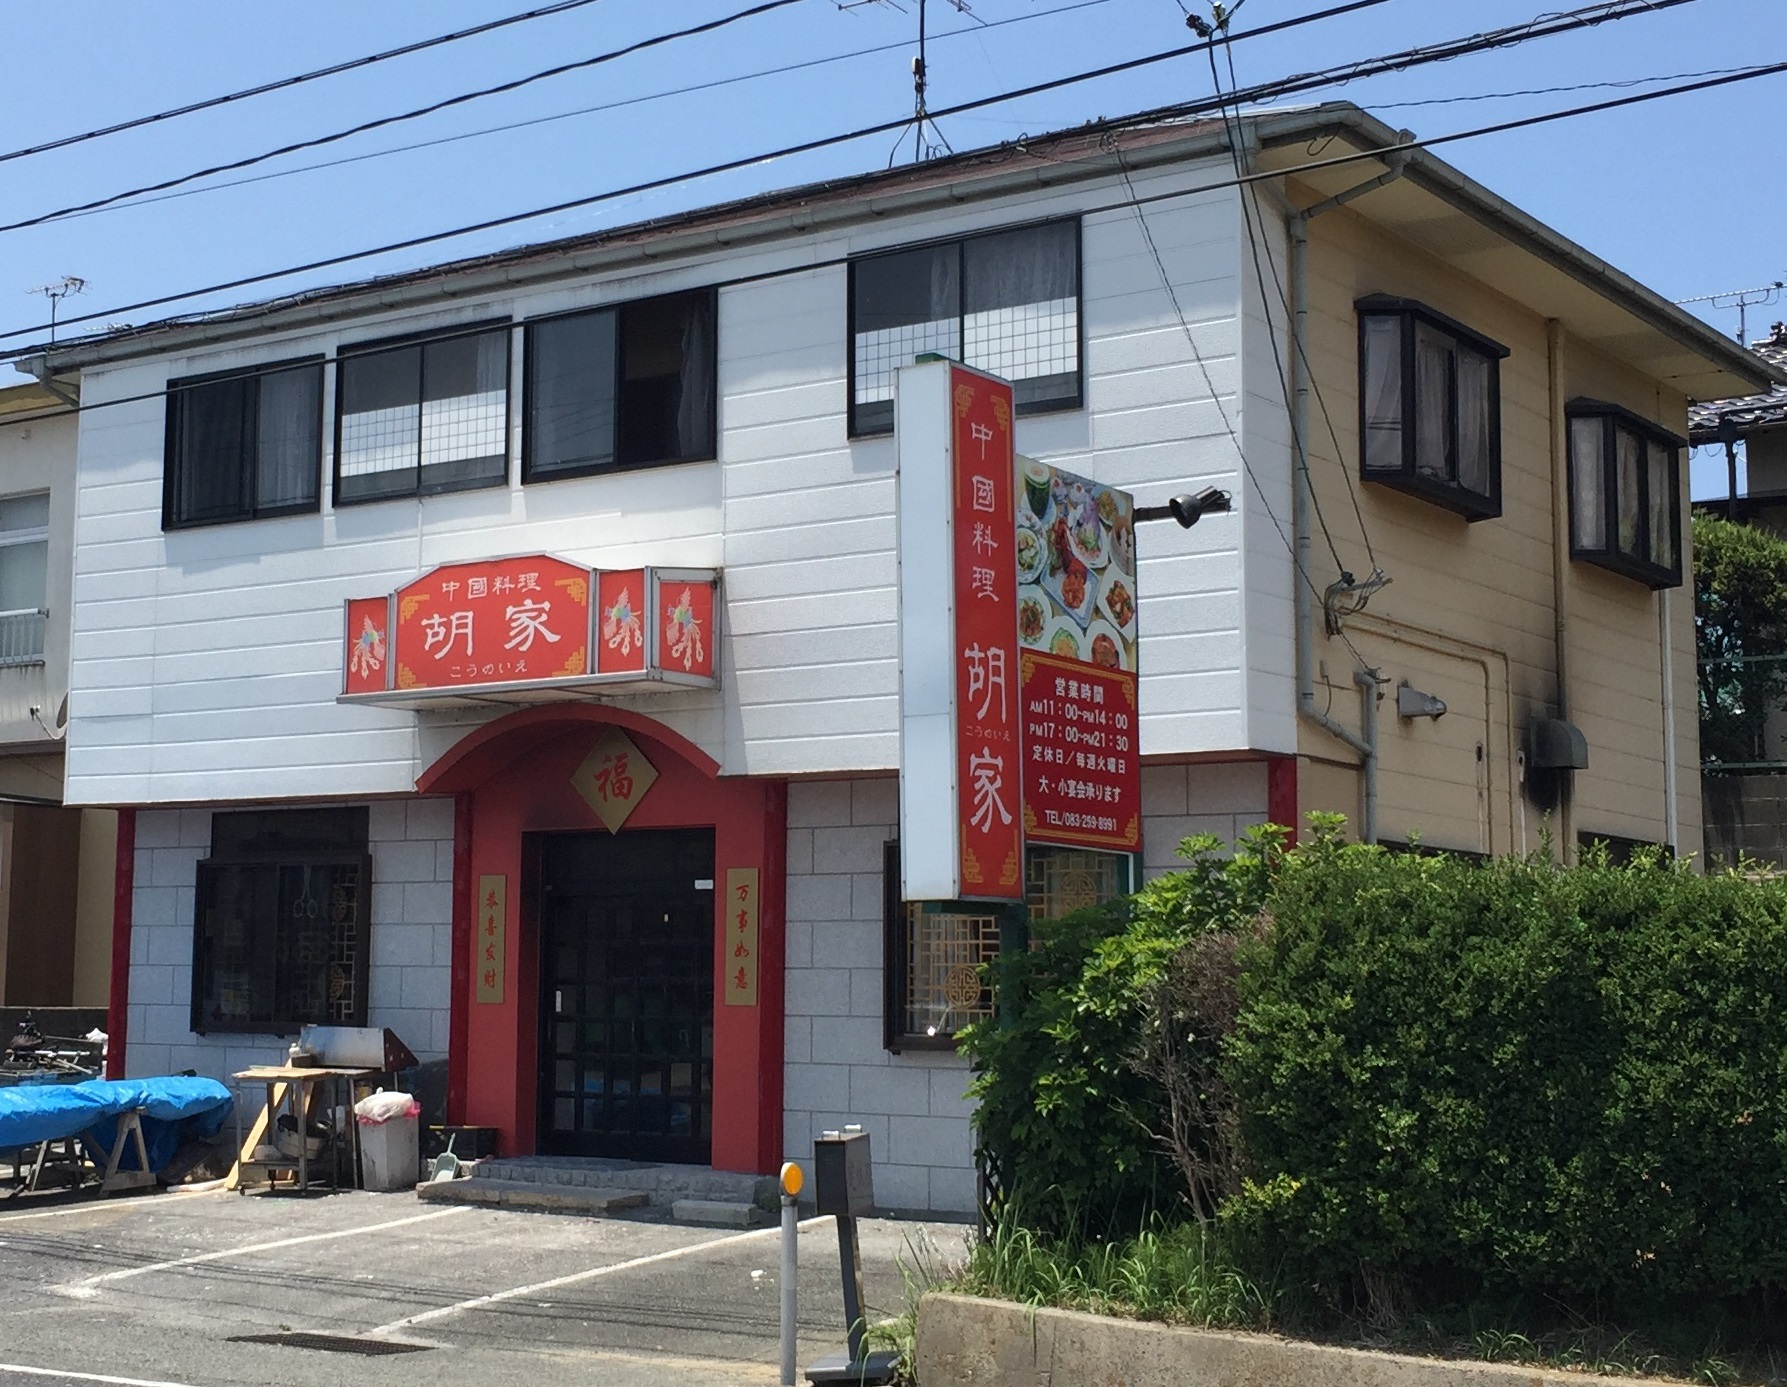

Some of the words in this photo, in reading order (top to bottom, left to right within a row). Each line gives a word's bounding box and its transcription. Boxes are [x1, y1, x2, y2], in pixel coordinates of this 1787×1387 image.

[971, 422, 999, 602] 中國料理
[442, 572, 541, 601] 中國料理
[421, 598, 561, 659] 胡家
[450, 660, 528, 678] こうのいえ
[1055, 677, 1104, 704] 営業時間
[965, 725, 1011, 742] こうのいえ
[594, 753, 633, 802] 福
